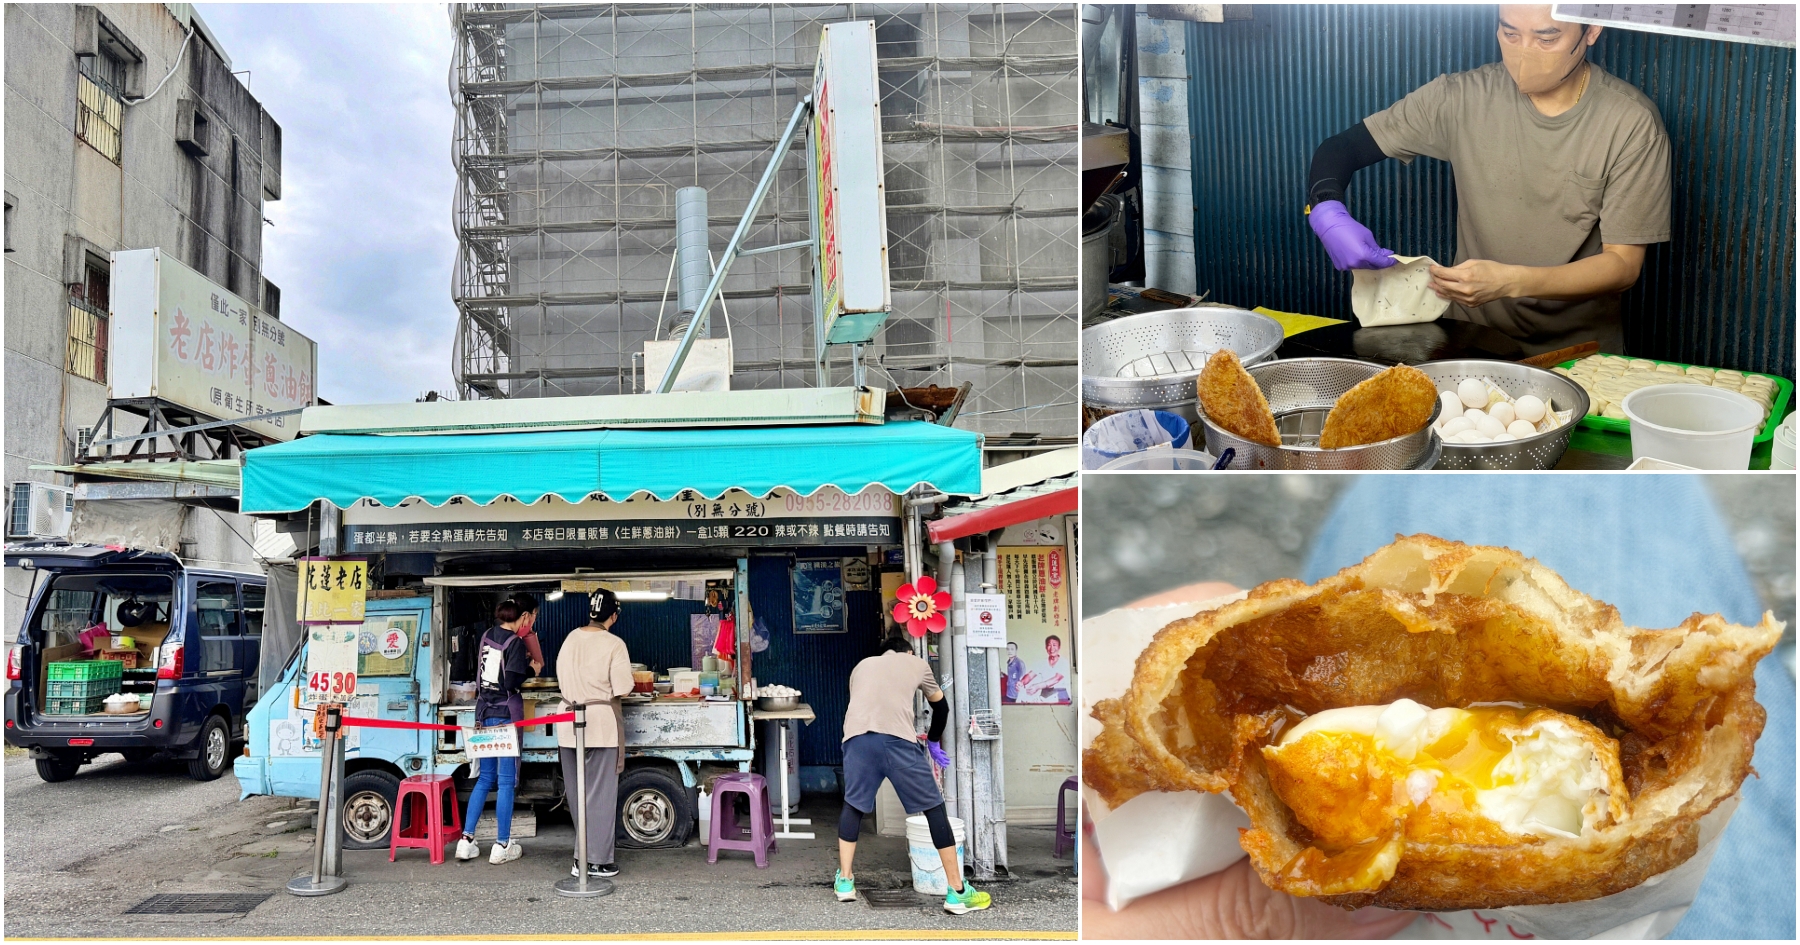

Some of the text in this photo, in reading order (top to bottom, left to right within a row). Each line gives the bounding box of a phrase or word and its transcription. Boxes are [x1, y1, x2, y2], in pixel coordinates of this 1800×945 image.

[210, 292, 285, 347] 僅此一家 別無分號
[687, 502, 766, 518] (別無分號)
[785, 492, 892, 513] 0955-282038
[734, 526, 769, 537] 220
[309, 672, 356, 694] 45 30
